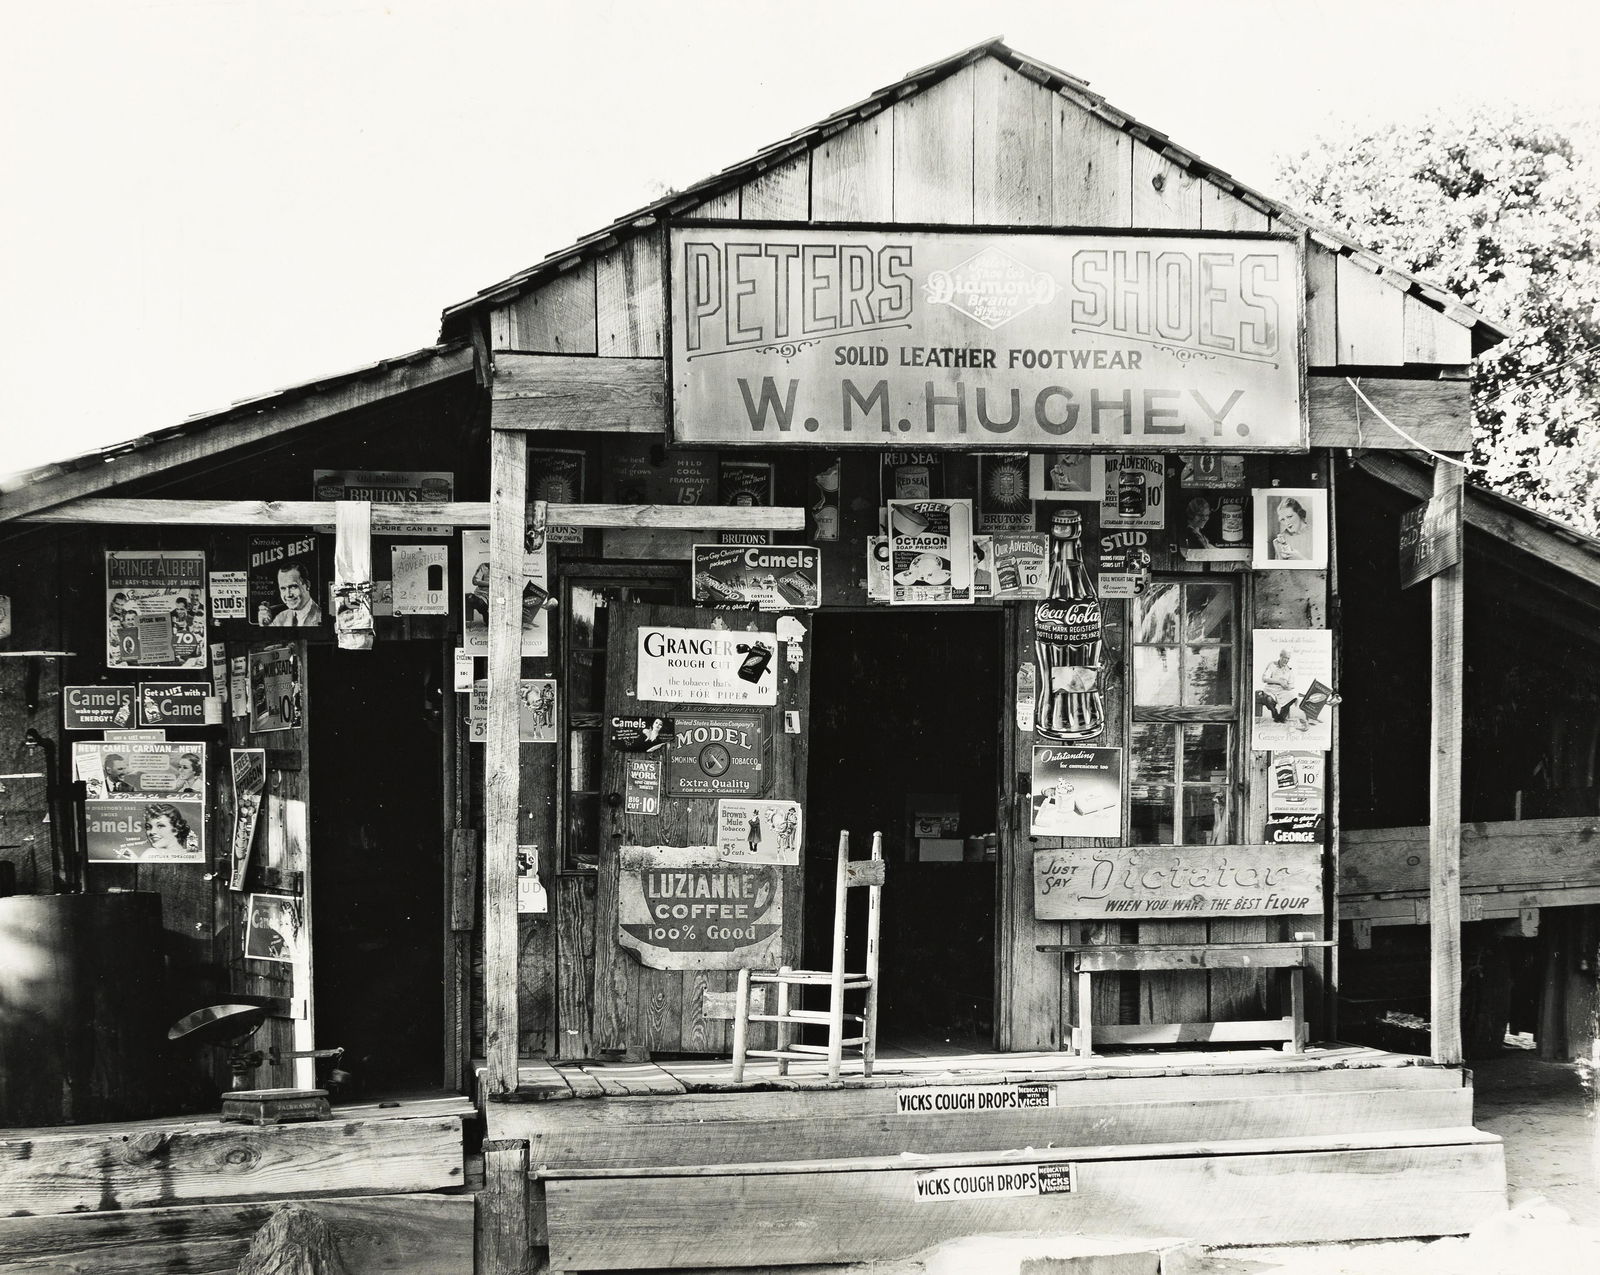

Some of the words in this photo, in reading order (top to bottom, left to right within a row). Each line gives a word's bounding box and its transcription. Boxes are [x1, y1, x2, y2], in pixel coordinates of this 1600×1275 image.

[684, 242, 913, 351] PETERS
[1071, 249, 1280, 355] SHOES
[967, 294, 1018, 307] Brand
[834, 346, 889, 368] SOLID
[900, 346, 997, 369] LEATHER
[1008, 349, 1143, 371] FOOTWEAR
[630, 456, 645, 464] best
[884, 453, 908, 467] RED
[911, 453, 940, 465] SEAL
[1118, 454, 1163, 475] ADVERTISER
[629, 469, 652, 477] grows
[896, 477, 911, 489] RED
[252, 537, 281, 546] Smoke
[895, 537, 948, 545] OCTAGON
[1101, 531, 1147, 552] STUD
[252, 547, 284, 568] DILL'S
[287, 537, 316, 557] BEST
[401, 550, 417, 560] OUR
[709, 552, 720, 560] Gay
[744, 548, 814, 568] Camels
[110, 560, 154, 577] PRINCE
[156, 559, 201, 577] ALBERT
[397, 552, 444, 574] ADVERTISER
[709, 558, 732, 570] packages
[732, 555, 739, 563] of
[213, 597, 235, 609] STUD
[1037, 601, 1100, 625] Coca-Cola
[175, 633, 194, 644] 70
[643, 632, 733, 657] GRANGER
[667, 659, 705, 669] ROUGH
[711, 661, 731, 669] CUT
[668, 677, 681, 686] the
[682, 677, 710, 686] tobacco
[69, 689, 131, 706] Camels
[144, 688, 159, 697] Get
[165, 686, 183, 697] LIFT
[184, 689, 200, 697] with
[652, 686, 683, 698] MADE
[690, 688, 709, 698] FOR
[160, 699, 205, 716] Came
[612, 717, 647, 729] Camels
[693, 719, 709, 727] States
[709, 719, 728, 727] Tobacco
[728, 720, 755, 729] Company's
[676, 727, 753, 750] MODEL
[102, 744, 131, 753] CAMEL
[179, 744, 202, 753] NEW!
[731, 757, 758, 765] TOBACCO
[1041, 749, 1095, 763] Outstanding
[235, 753, 250, 774] FREE
[631, 771, 657, 780] WORK
[679, 778, 709, 787] Extra
[711, 778, 750, 790] Quality
[722, 810, 747, 818] Brown's
[87, 816, 142, 833] amels
[726, 818, 743, 826] Mule
[1273, 829, 1315, 843] GEORGE
[1042, 859, 1079, 876] JUST
[1077, 854, 1290, 902] Dictator
[648, 873, 754, 899] LUZIANNE
[1042, 876, 1072, 895] SAY
[1104, 899, 1142, 912] WHEN
[1146, 899, 1168, 911] YOU
[1210, 898, 1232, 911] THE
[1234, 896, 1263, 910] BEST
[1265, 894, 1310, 910] FLOUR
[655, 904, 749, 919] COFFEE
[648, 924, 696, 940] 100%
[706, 925, 756, 940] Good
[899, 1093, 933, 1111] VICKS
[935, 1092, 975, 1111] COUGH
[978, 1091, 1017, 1109] DROPS
[1019, 1097, 1049, 1108] VICKS
[1038, 1166, 1069, 1174] MEDICATED
[916, 1177, 951, 1196] VICKS
[953, 1175, 994, 1194] COUGH
[998, 1172, 1037, 1192] DROPS
[1039, 1177, 1070, 1192] VICKS
